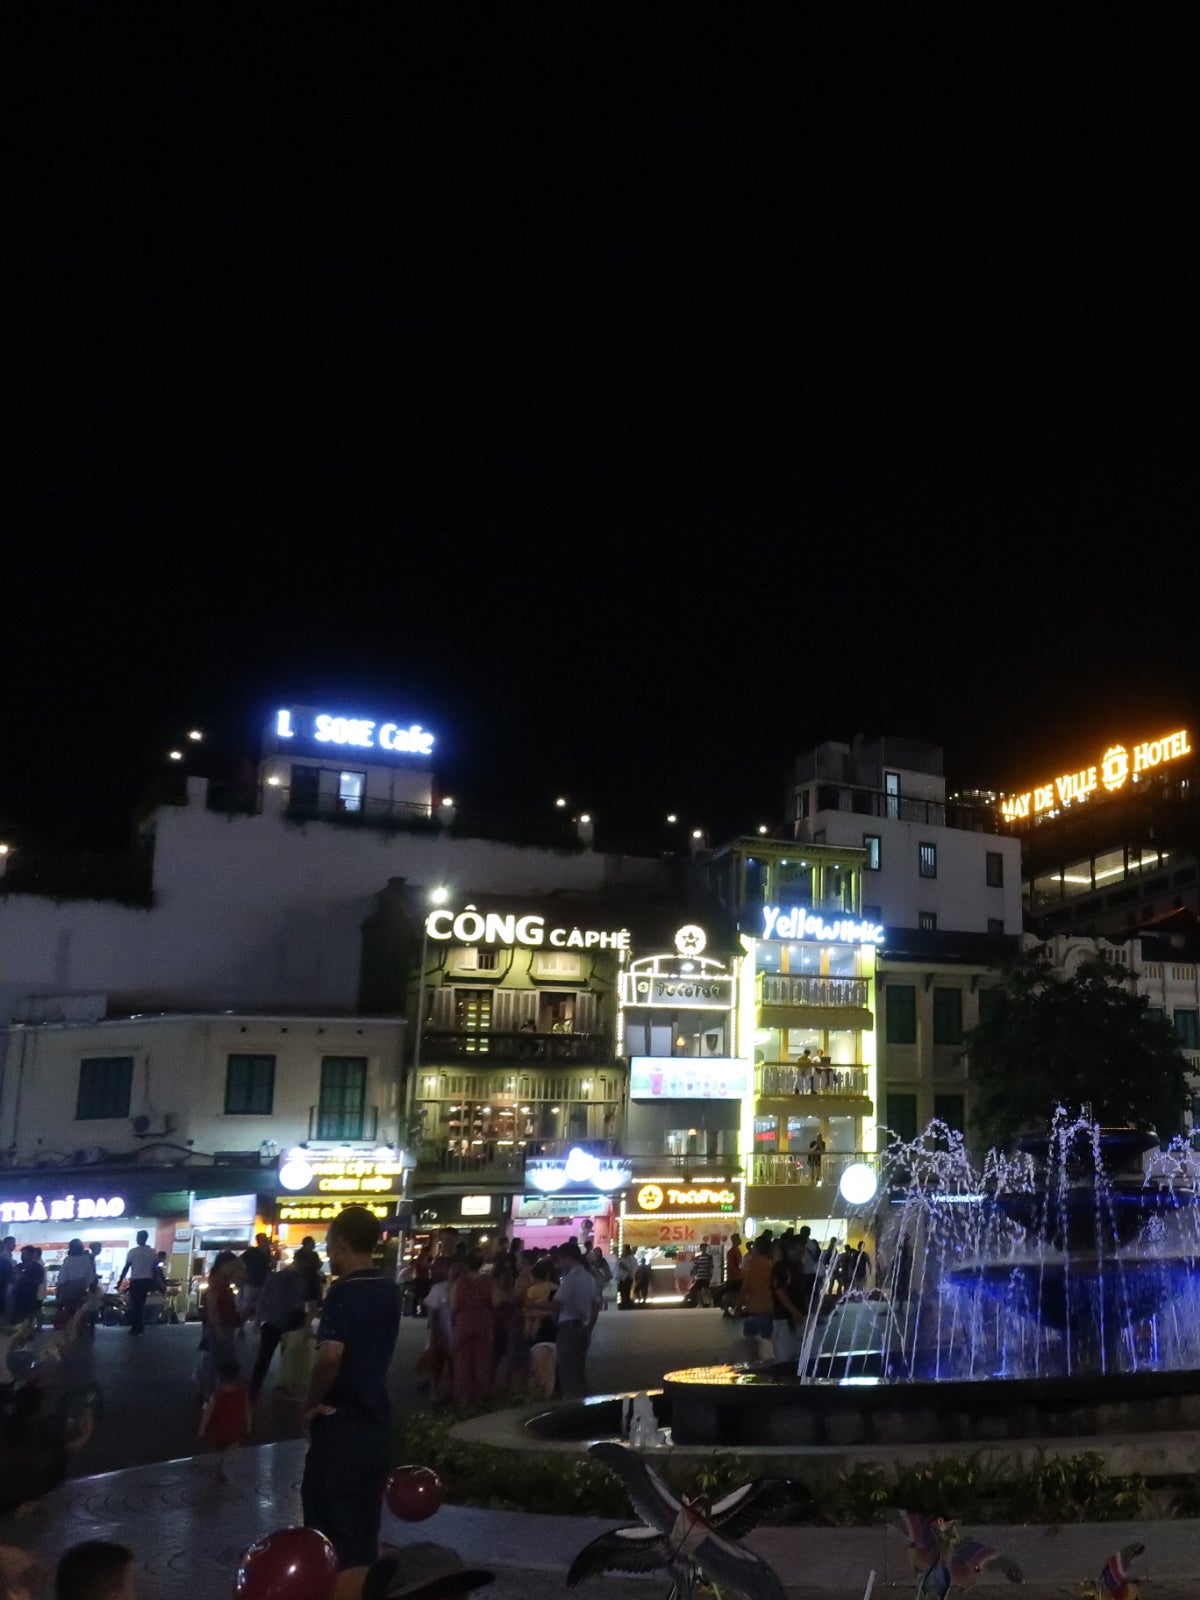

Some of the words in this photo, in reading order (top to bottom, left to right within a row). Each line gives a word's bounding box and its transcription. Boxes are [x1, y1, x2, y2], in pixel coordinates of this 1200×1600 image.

[1002, 793, 1031, 822] MAY
[1033, 783, 1053, 811] DE
[1133, 730, 1191, 772] HOTEL
[660, 1225, 695, 1241] 25k
